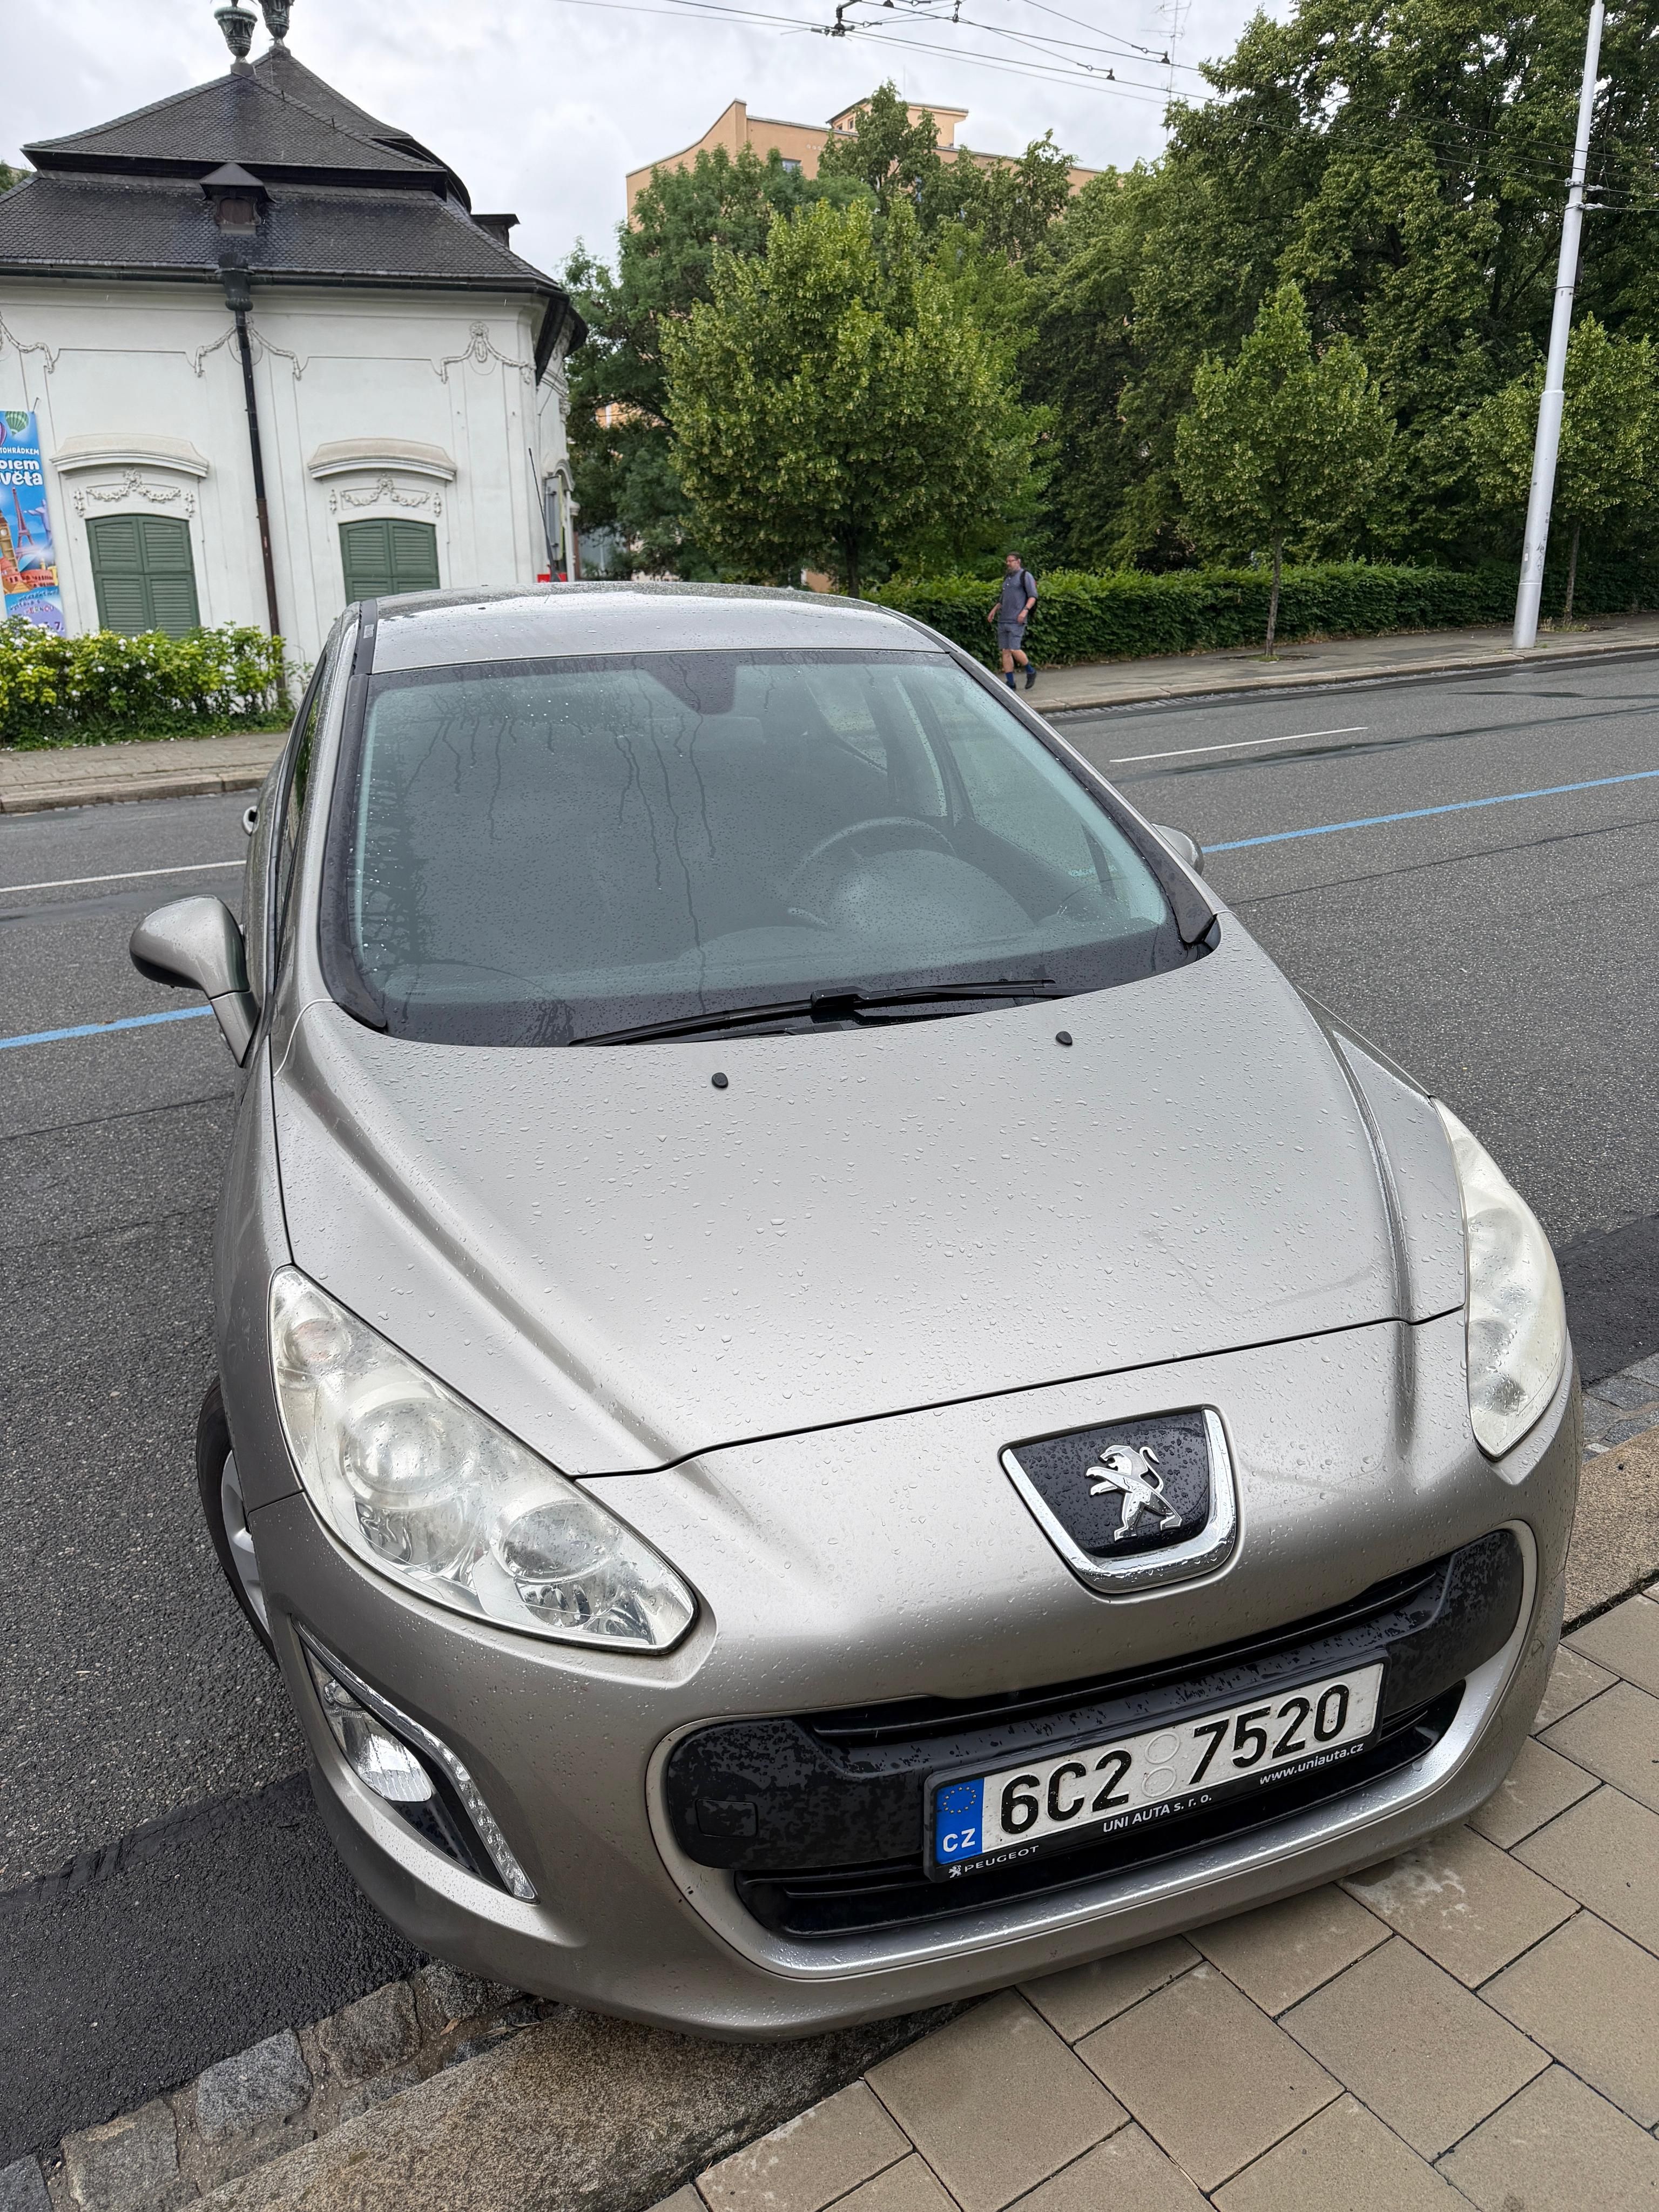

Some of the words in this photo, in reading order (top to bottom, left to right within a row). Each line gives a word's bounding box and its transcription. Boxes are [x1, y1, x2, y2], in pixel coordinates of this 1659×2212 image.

[0, 470, 43, 486] věta
[1001, 1750, 1132, 1835] 6C2
[1189, 1684, 1350, 1785] 7520
[1259, 1743, 1364, 1785] www.uniauta.cz
[1103, 1816, 1129, 1832] UNI
[1132, 1804, 1170, 1824] AUTA
[1174, 1802, 1184, 1811] s.
[1188, 1798, 1197, 1807] r.
[1201, 1795, 1212, 1803] o.
[943, 1827, 976, 1852] CZ
[965, 1845, 1040, 1872] PEUGEOT
